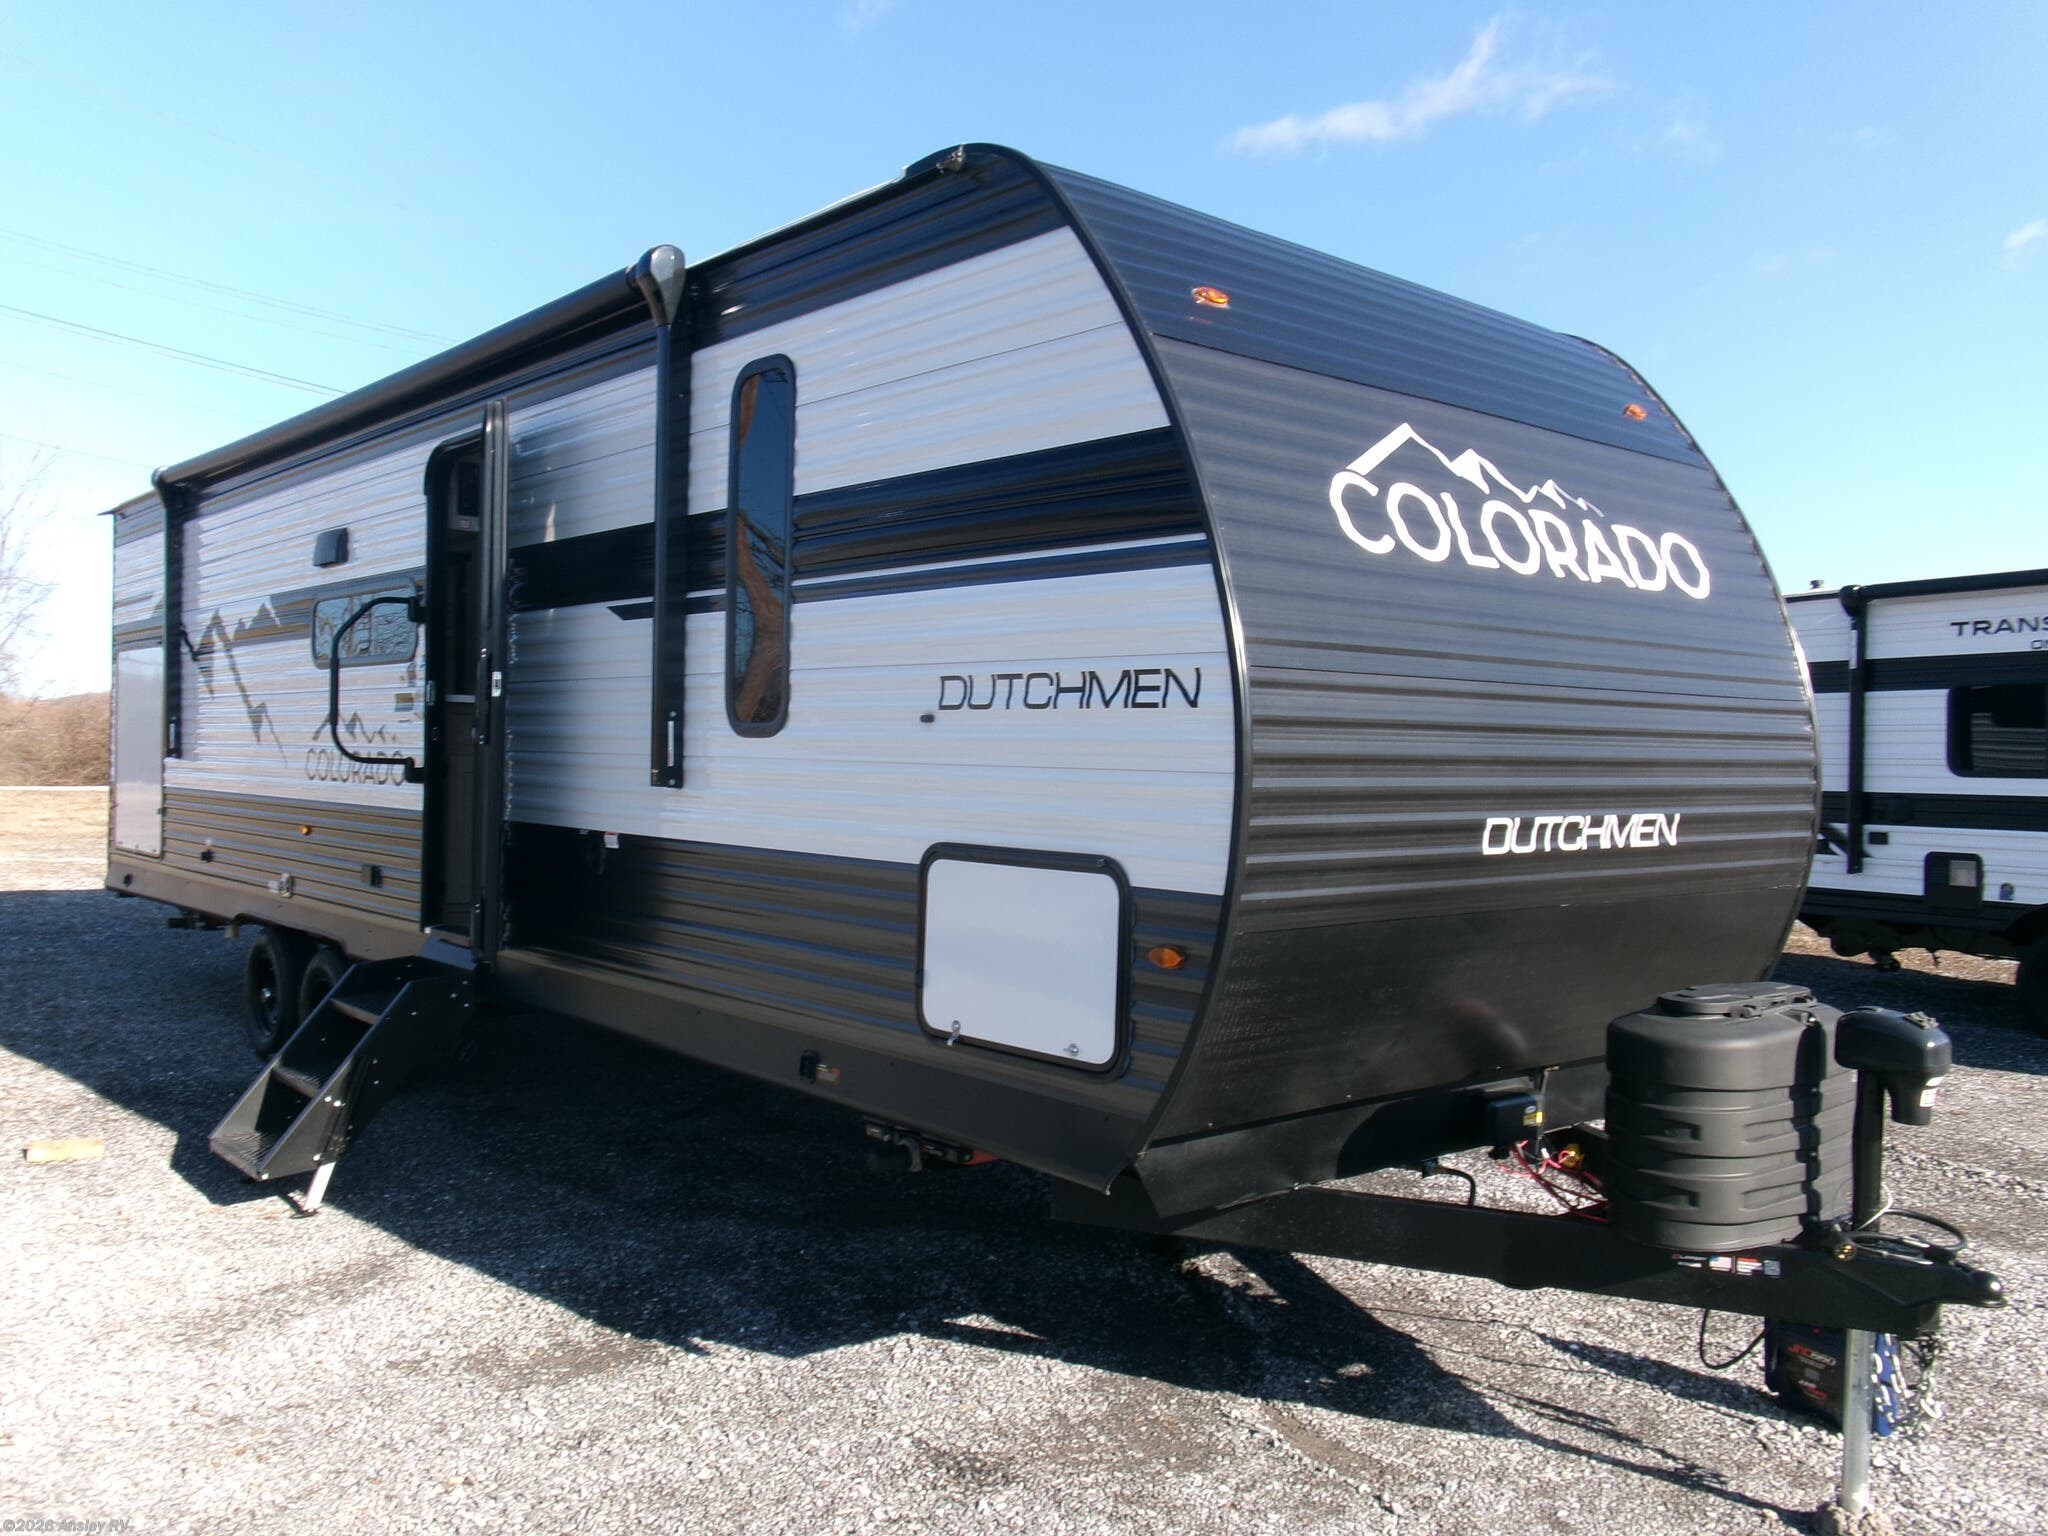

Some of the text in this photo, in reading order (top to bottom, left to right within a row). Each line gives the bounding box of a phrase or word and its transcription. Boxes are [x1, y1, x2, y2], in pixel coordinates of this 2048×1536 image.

[1329, 470, 1711, 599] COLORADO
[938, 667, 1201, 711] DUTCHMEN
[304, 747, 405, 786] COLORADO
[1482, 812, 1681, 856] DUTCHMEN
